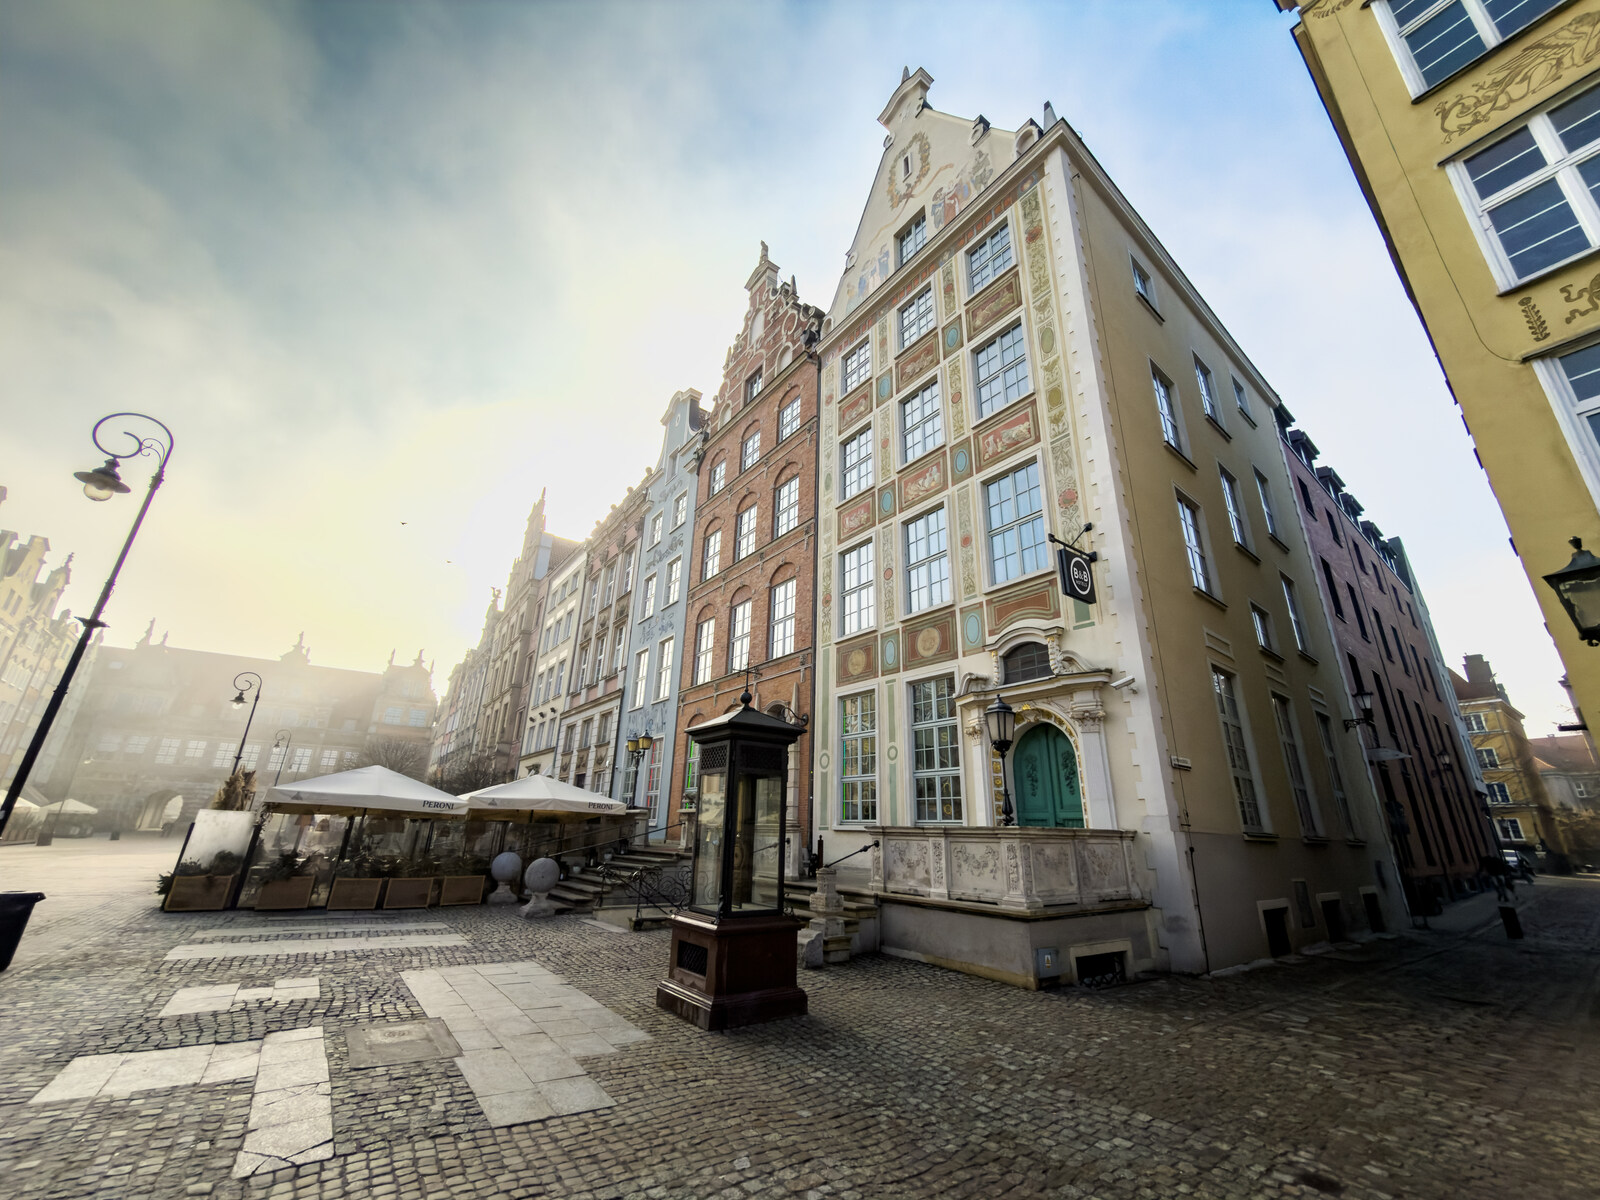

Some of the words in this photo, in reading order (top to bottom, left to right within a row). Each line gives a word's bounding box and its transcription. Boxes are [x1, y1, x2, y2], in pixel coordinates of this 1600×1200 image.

[1073, 567, 1088, 582] B&B
[422, 800, 455, 810] PERONI
[588, 802, 613, 810] PERONI
